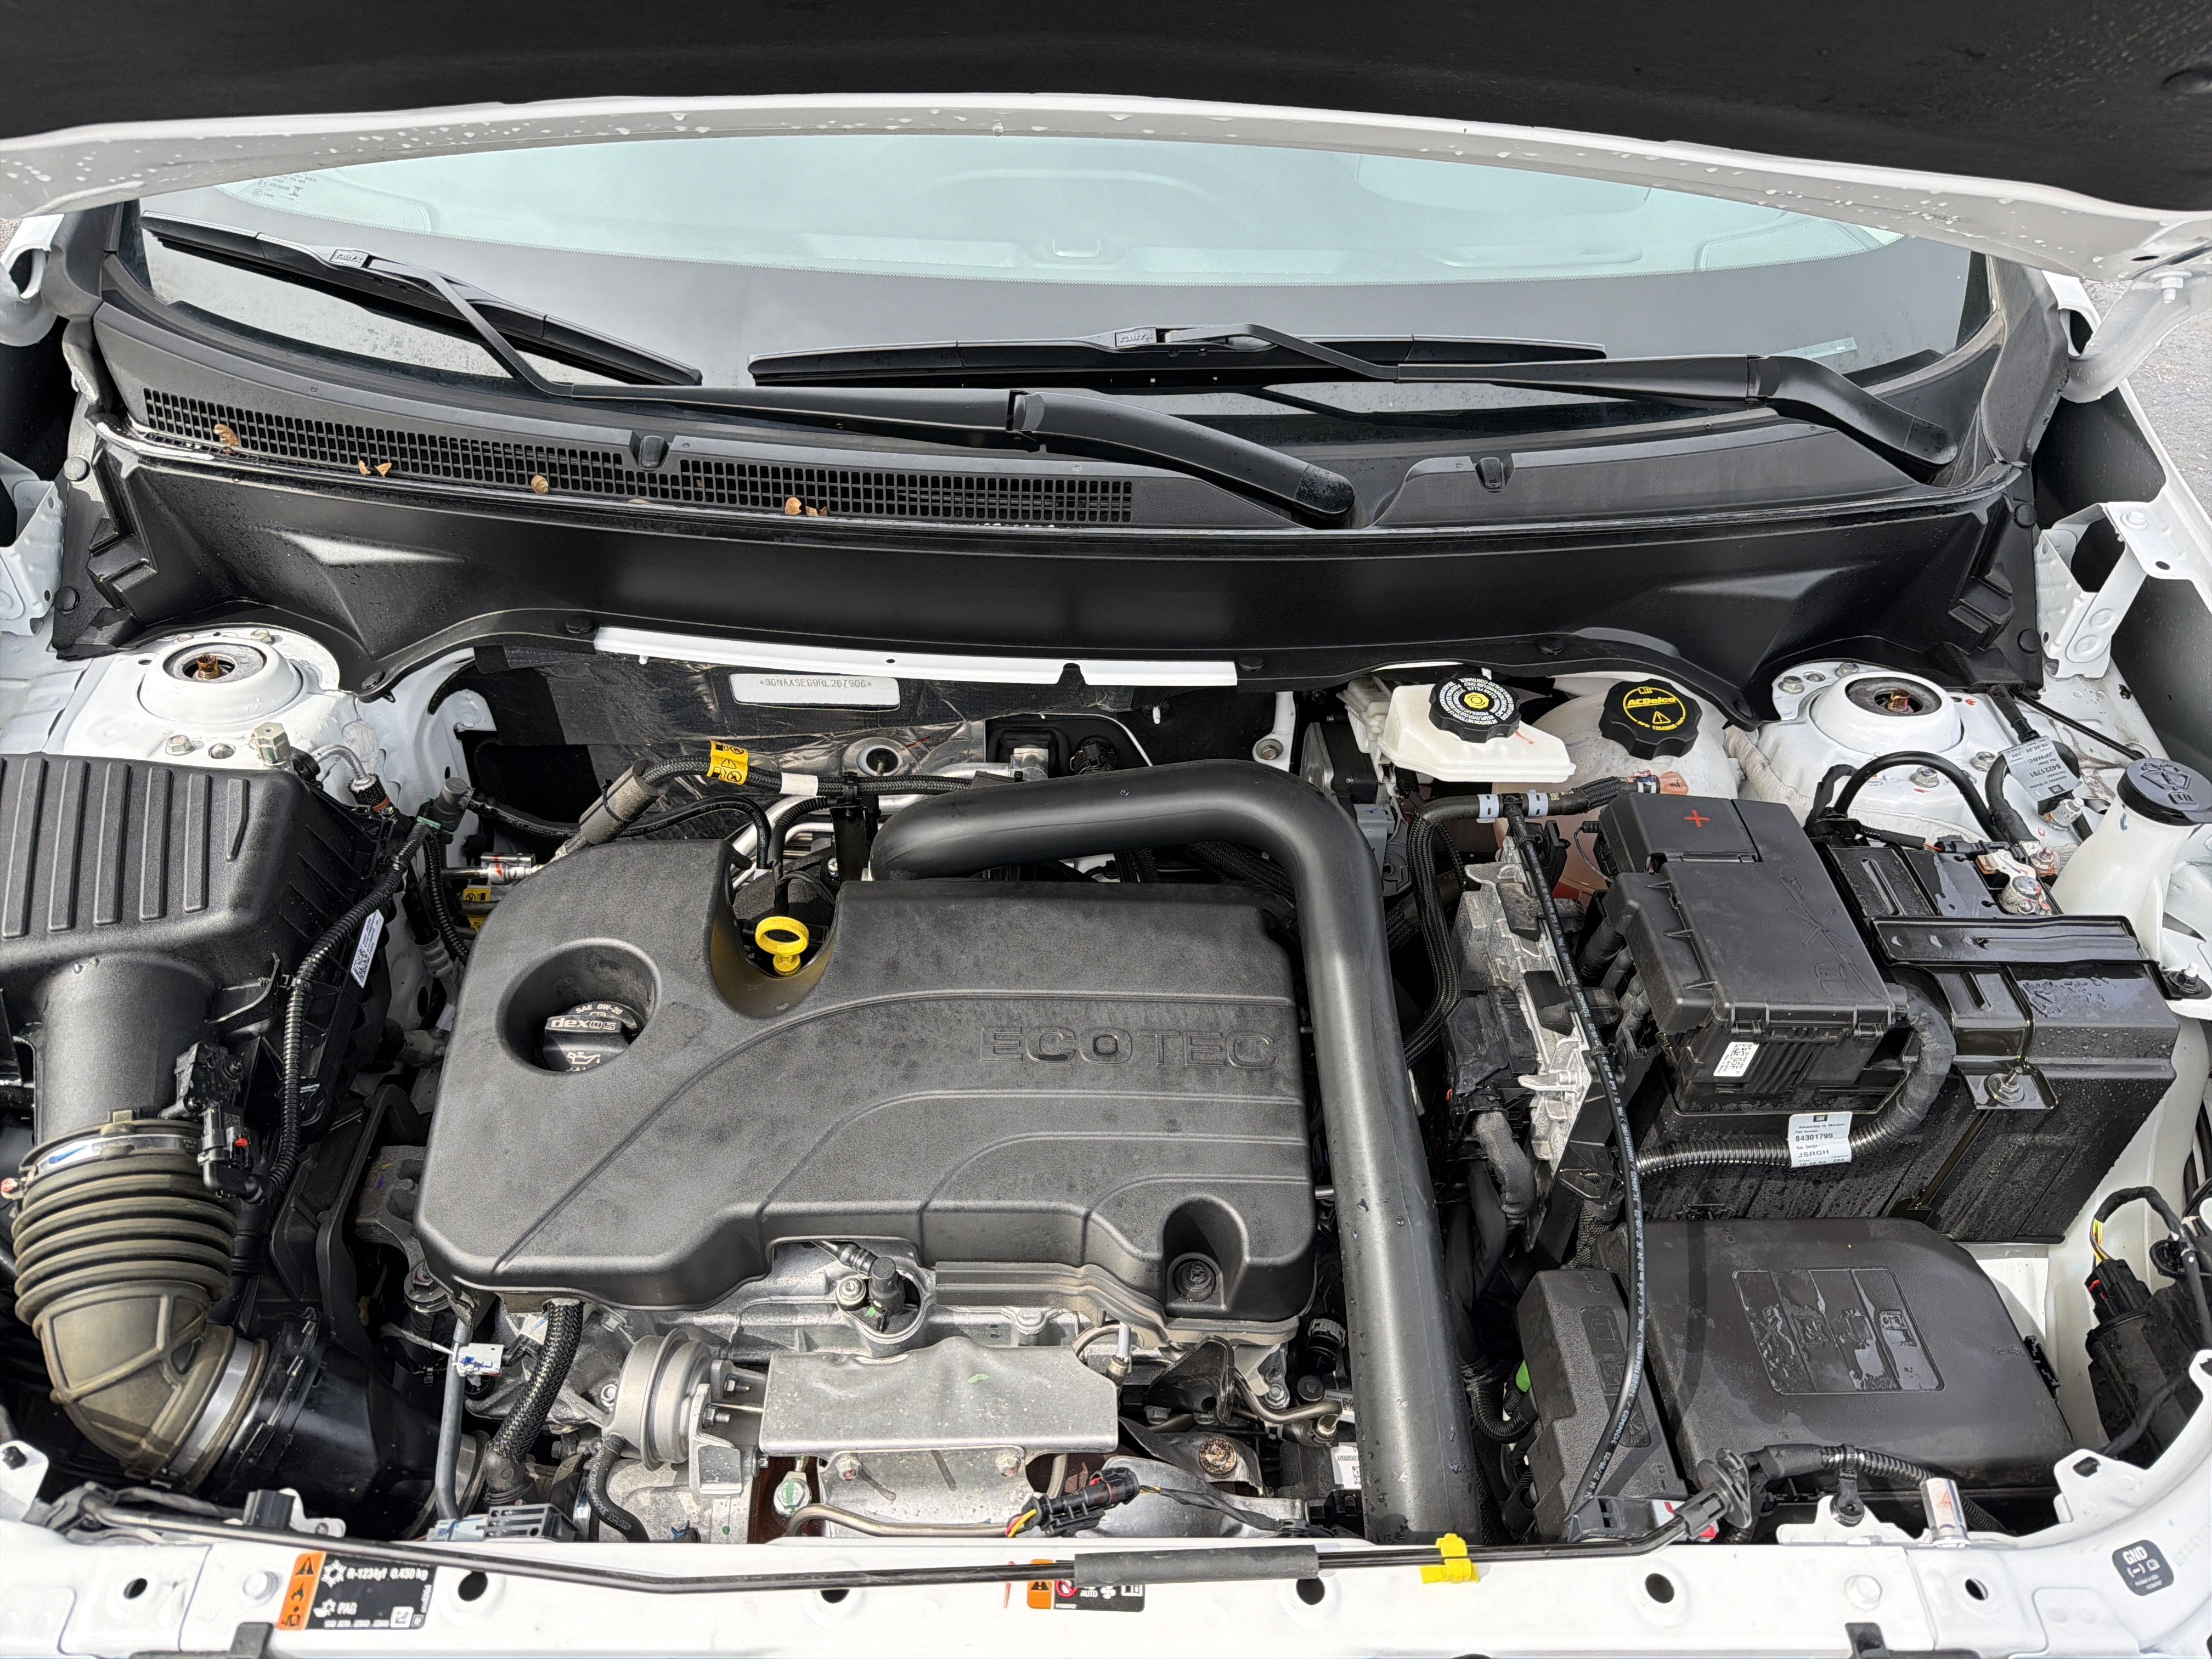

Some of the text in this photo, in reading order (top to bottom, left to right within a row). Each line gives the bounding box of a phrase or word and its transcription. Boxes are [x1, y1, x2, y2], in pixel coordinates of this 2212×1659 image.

[1627, 697, 1677, 706] ACDelco
[2028, 752, 2053, 764] JPNBC
[2029, 764, 2062, 778] 84221791
[575, 1004, 624, 1015] SAE 0W-20
[551, 1018, 616, 1030] dexos
[980, 1026, 1277, 1070] ECOTEC
[1795, 1133, 1833, 1142] 84301795
[1798, 1149, 1829, 1158] JSRGH
[2122, 1546, 2148, 1565] GND
